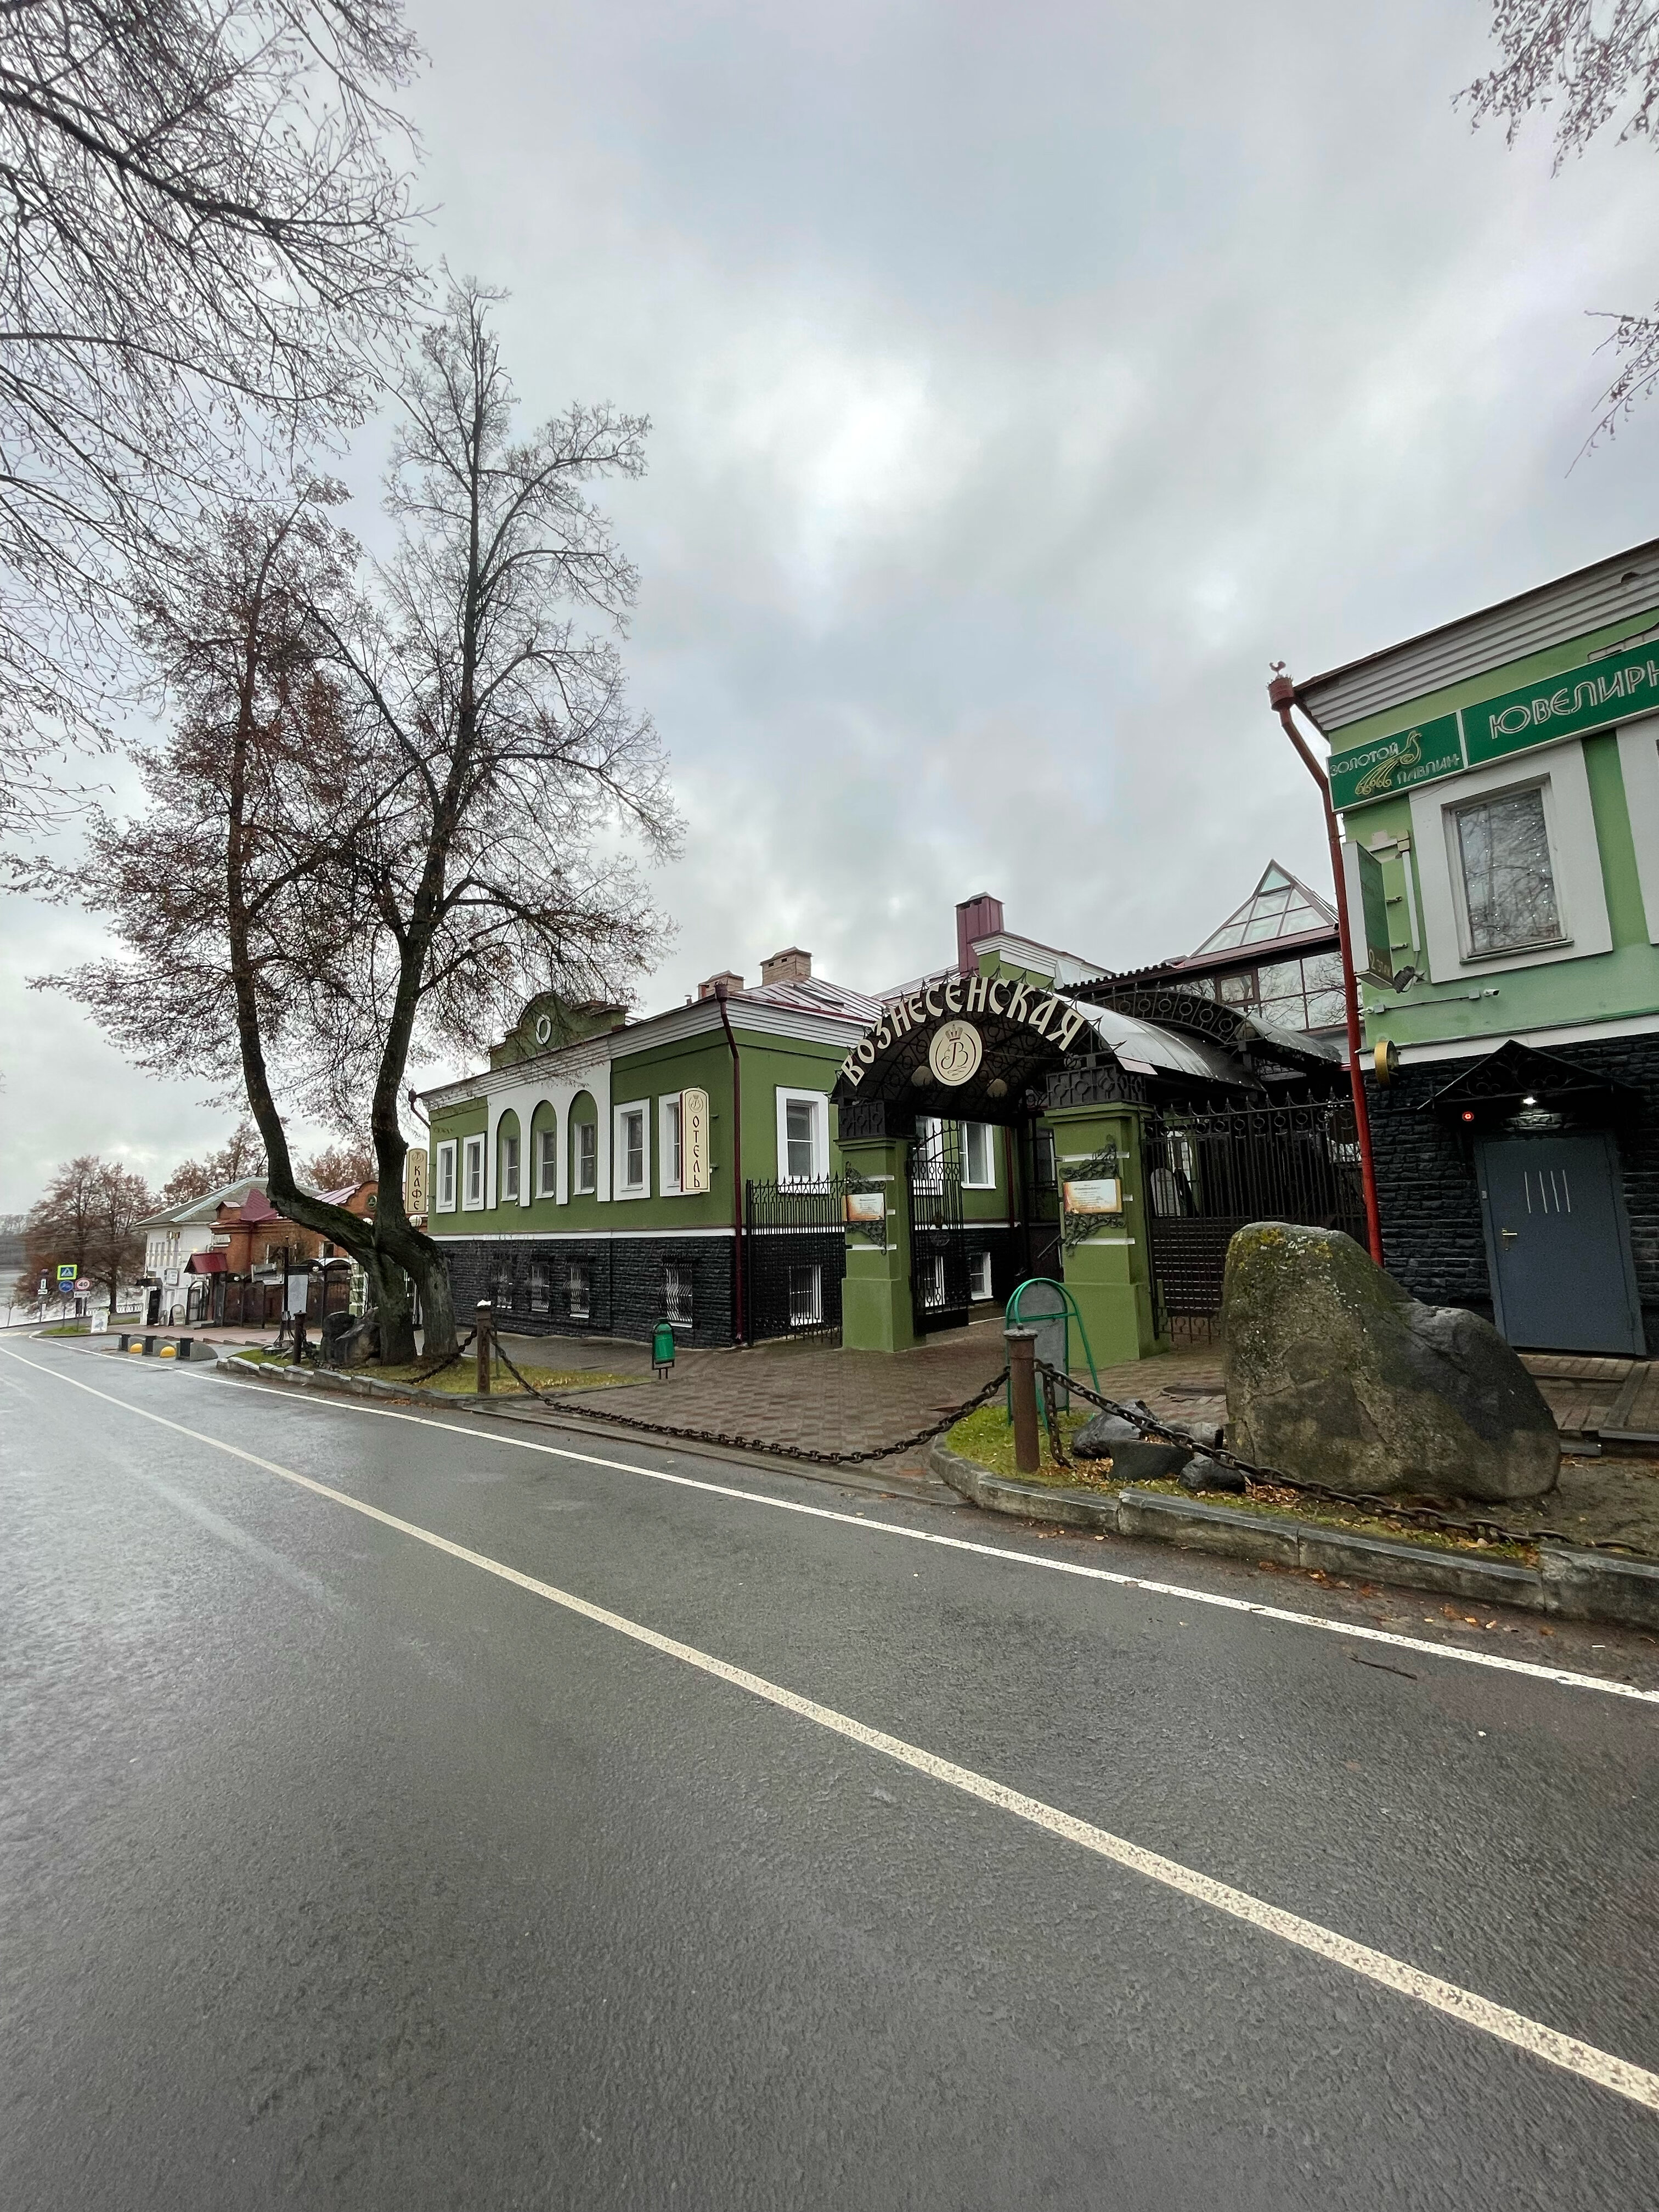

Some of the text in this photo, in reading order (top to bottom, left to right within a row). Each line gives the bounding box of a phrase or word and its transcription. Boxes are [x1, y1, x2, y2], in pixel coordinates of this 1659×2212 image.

[1330, 742, 1399, 777] ЗОЛОТОЙ
[1397, 753, 1460, 785] ПАВЛИН
[841, 977, 1085, 1087] ВОЗНЕСЕНСКАЯ
[692, 1115, 701, 1188] ОТЕЛЬ
[411, 1165, 422, 1210] КАФЕ
